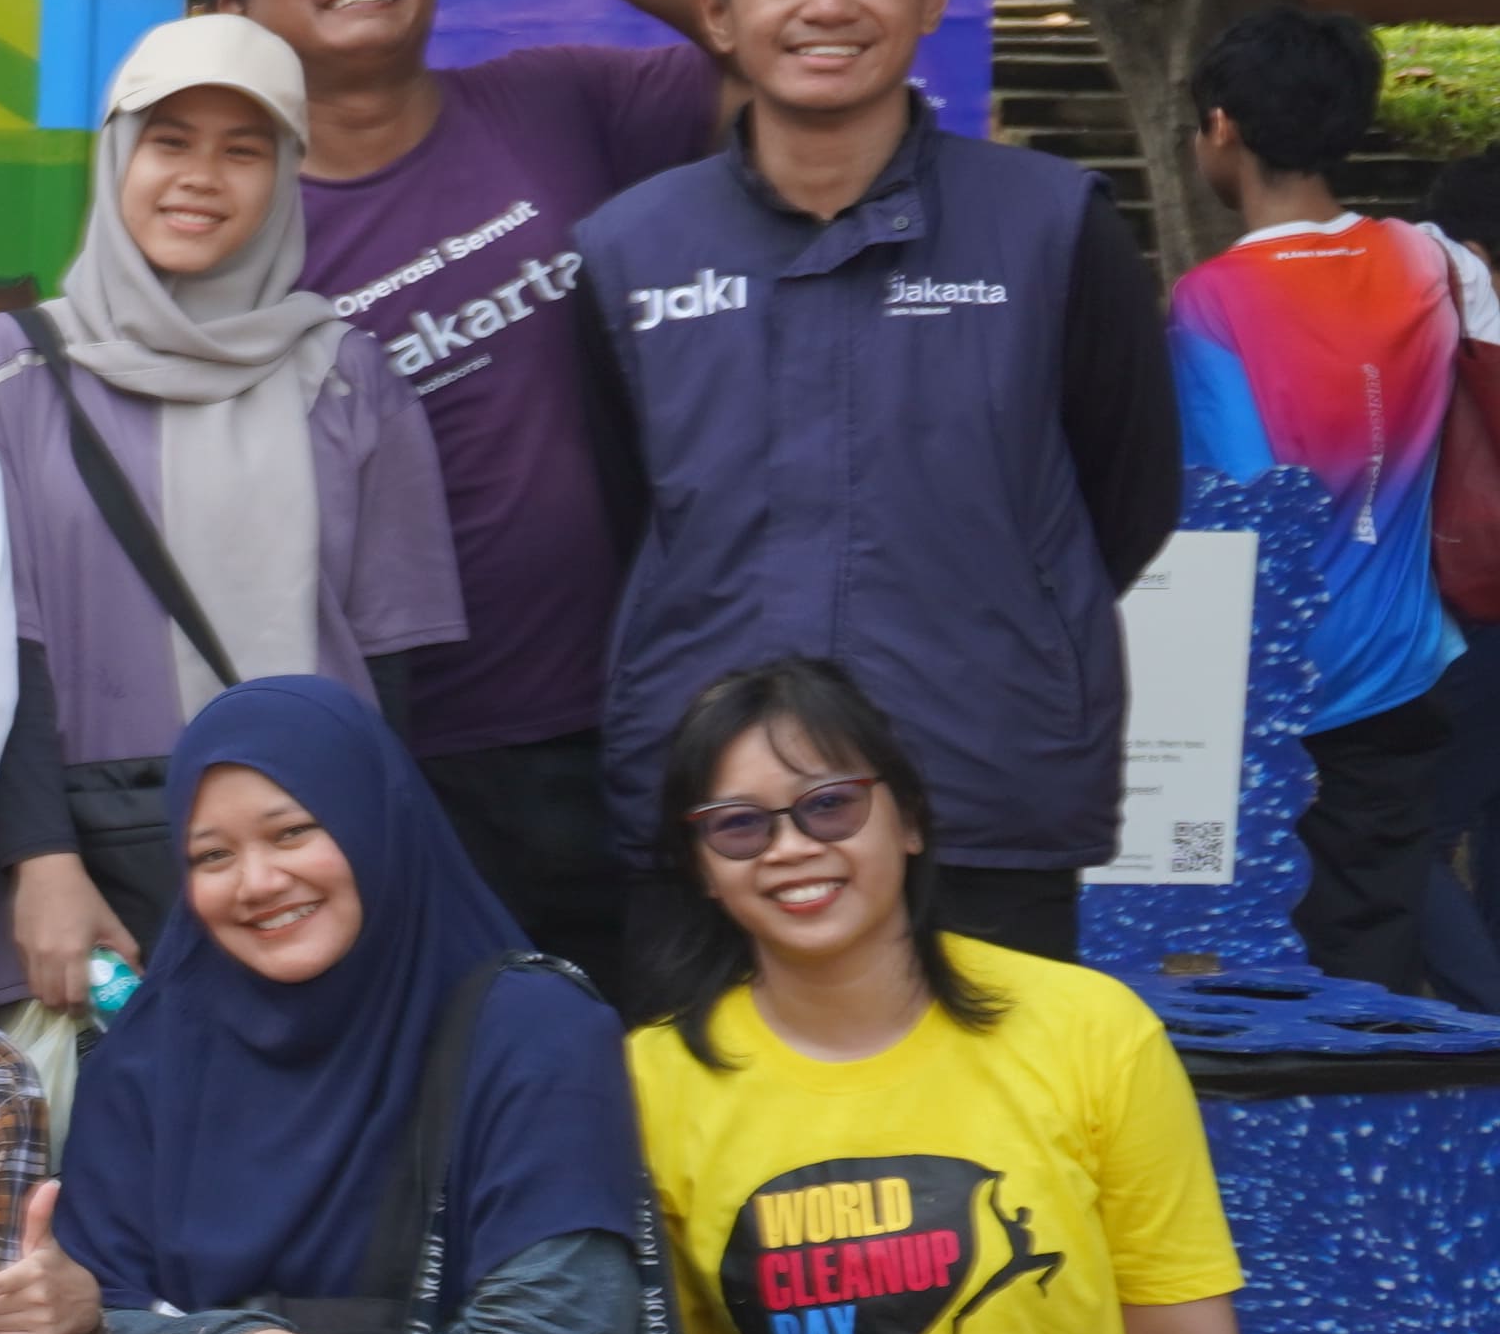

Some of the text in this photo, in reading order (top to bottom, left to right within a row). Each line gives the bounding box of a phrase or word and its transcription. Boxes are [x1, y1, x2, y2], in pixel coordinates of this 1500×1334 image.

[439, 200, 540, 262] Semut
[378, 251, 584, 378] akart
[756, 1174, 912, 1244] WORLD
[758, 1228, 962, 1314] CLEANUP
